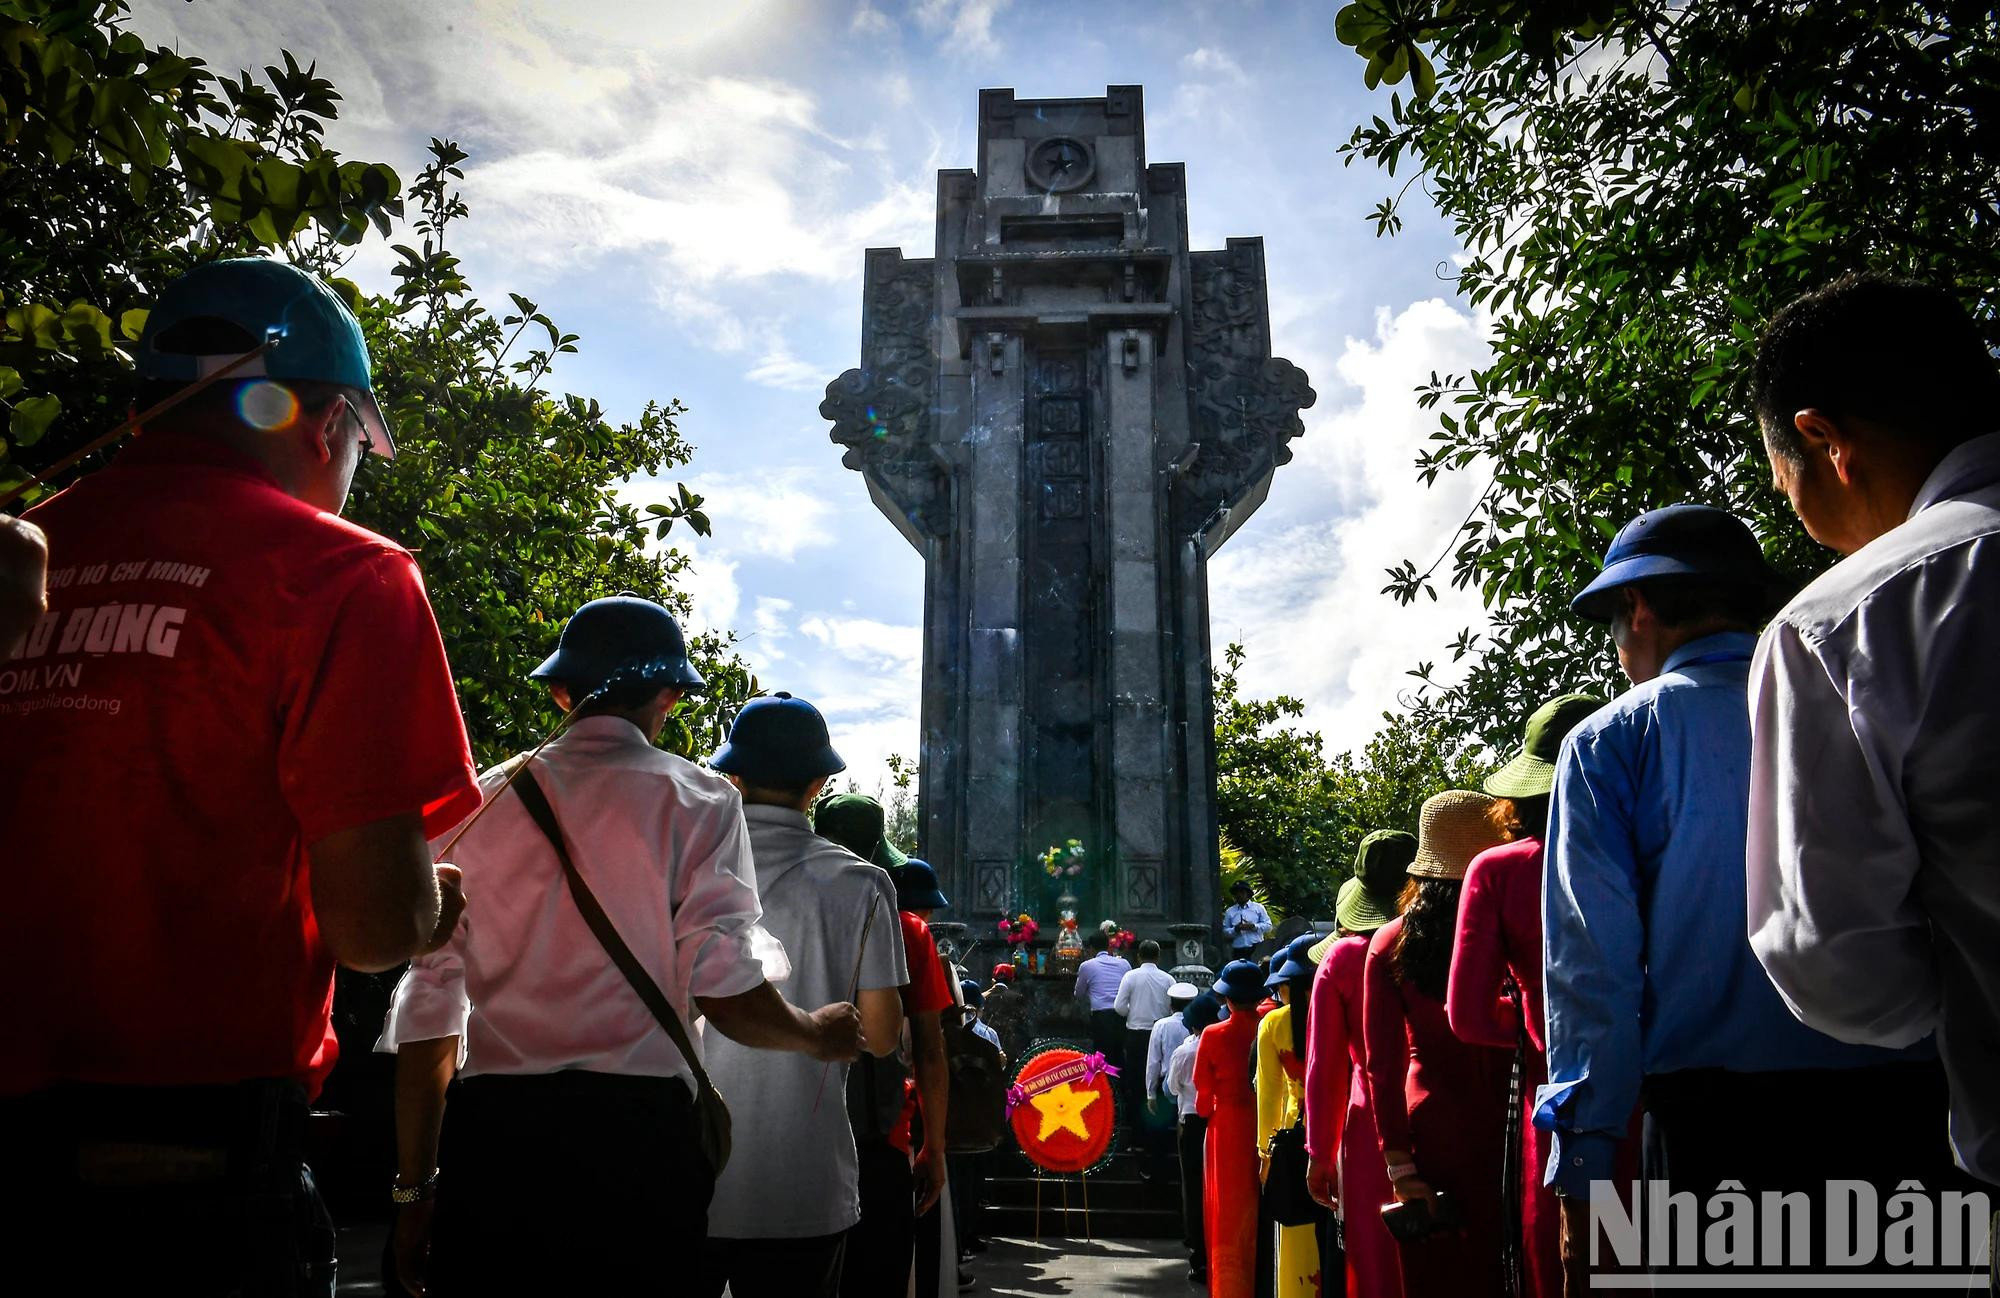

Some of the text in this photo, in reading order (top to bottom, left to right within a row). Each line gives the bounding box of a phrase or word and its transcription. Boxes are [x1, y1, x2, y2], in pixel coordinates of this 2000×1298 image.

[111, 559, 148, 582] CHÍ
[147, 561, 210, 588] MINH
[57, 600, 187, 658] ĐỘNG
